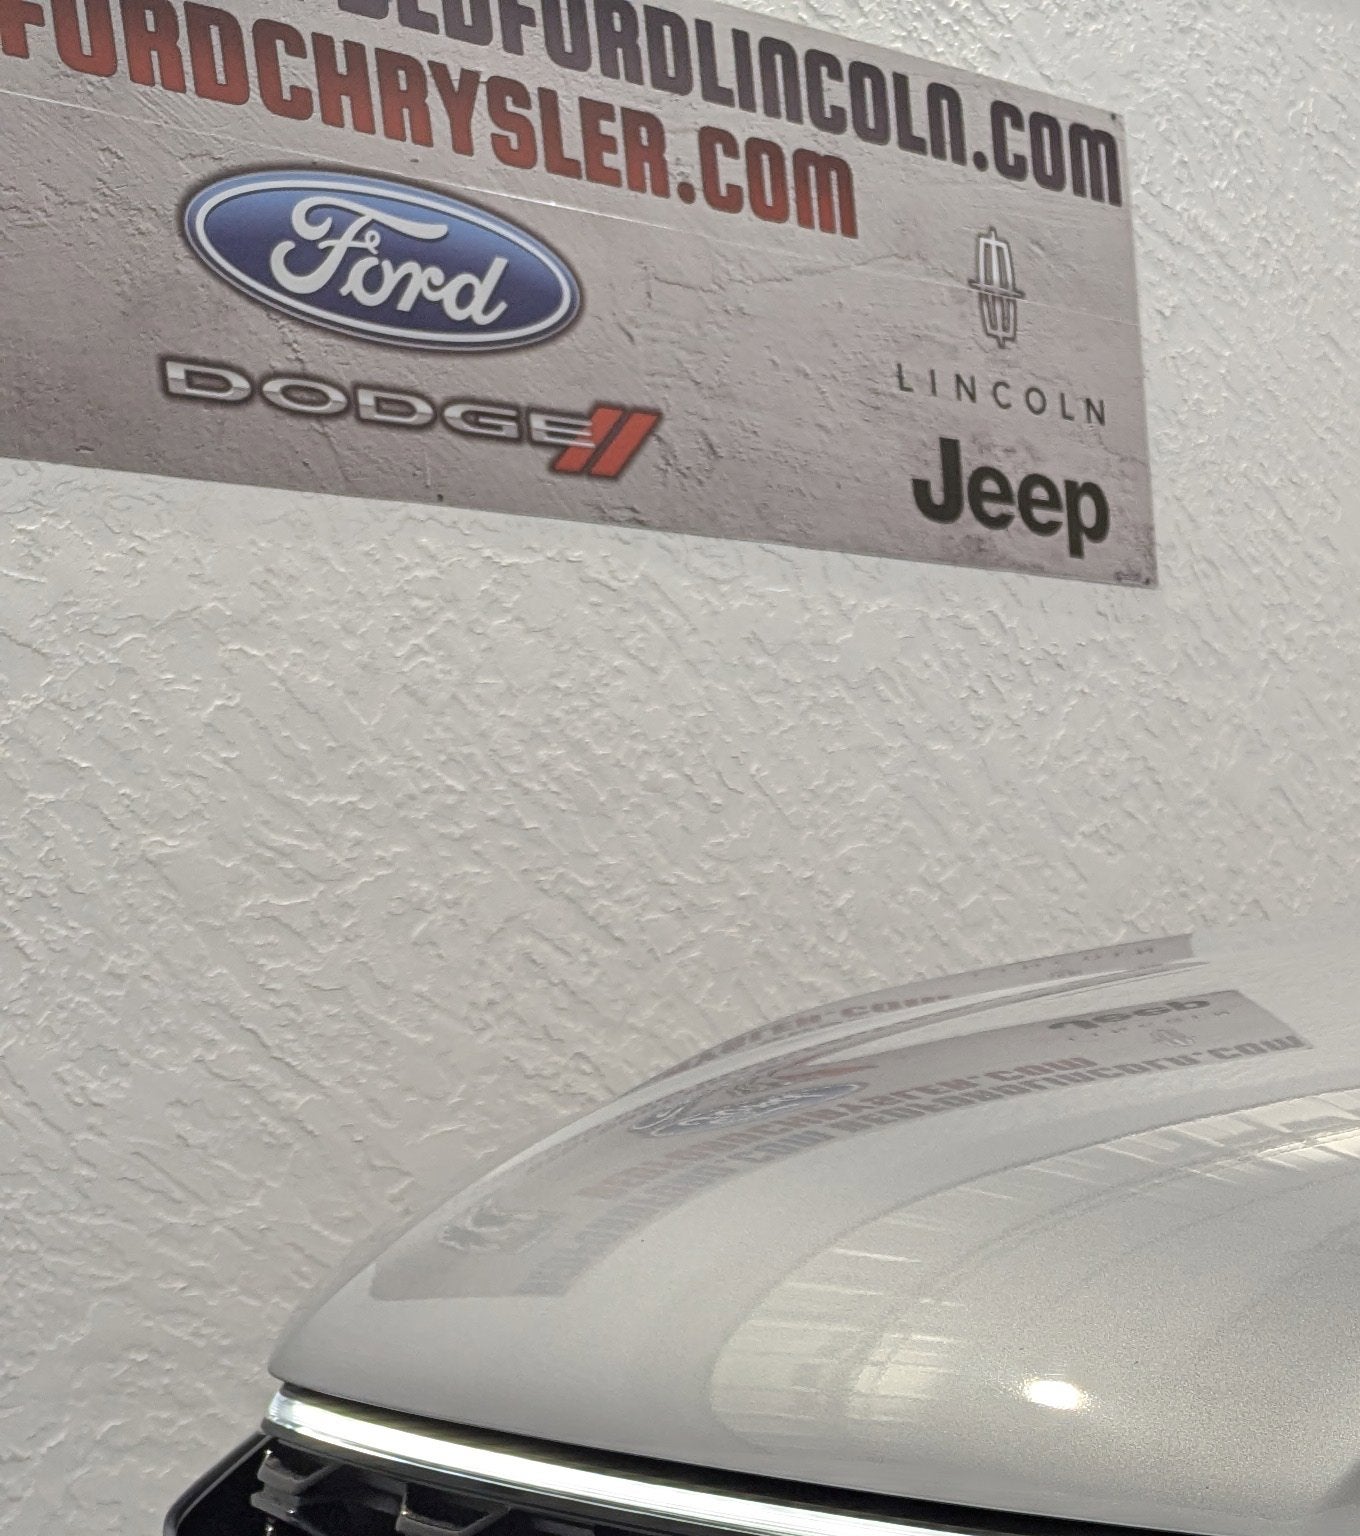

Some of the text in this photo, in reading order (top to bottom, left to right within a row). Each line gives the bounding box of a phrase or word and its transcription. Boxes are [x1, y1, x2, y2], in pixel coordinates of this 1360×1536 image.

[338, 0, 1123, 208] FORDLINCOLN.COM
[269, 197, 508, 326] Ford
[165, 360, 596, 450] DODGE
[897, 362, 1106, 426] LINCOLN
[911, 436, 1111, 560] Jeep
